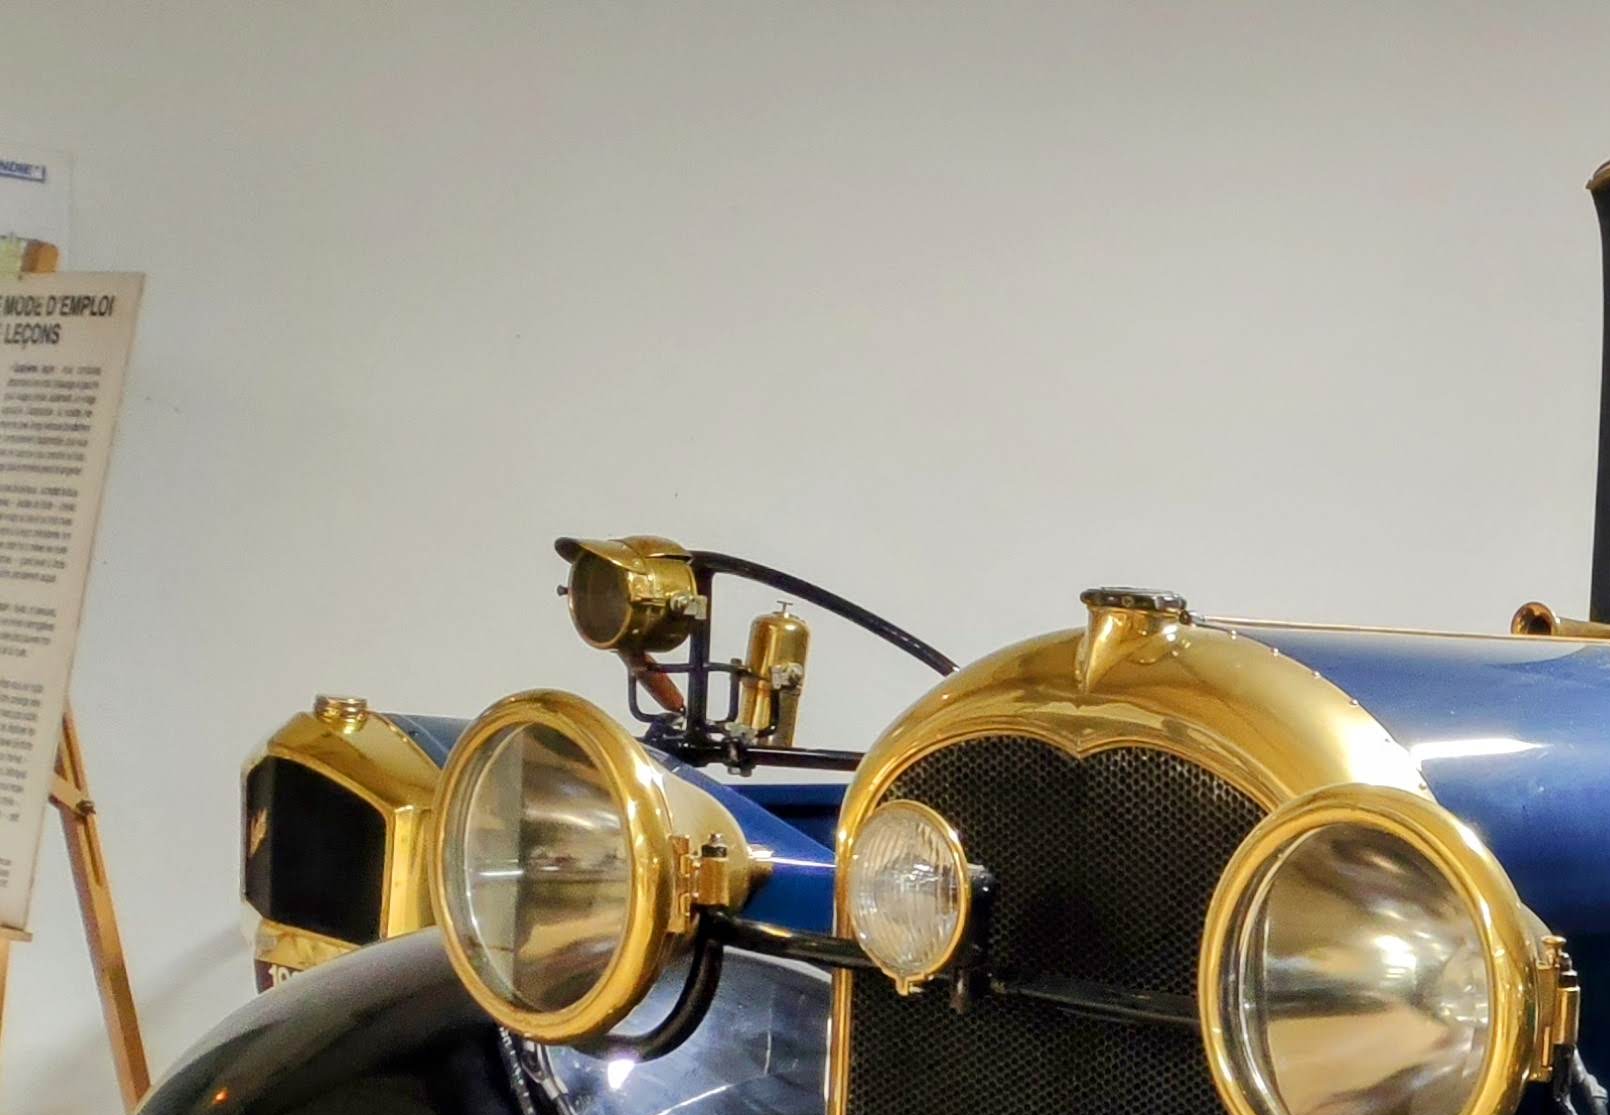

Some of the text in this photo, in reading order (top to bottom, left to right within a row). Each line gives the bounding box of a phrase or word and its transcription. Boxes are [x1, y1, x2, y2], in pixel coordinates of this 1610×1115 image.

[3, 295, 115, 318] MODE D'EMPLOI
[4, 322, 61, 349] LEÇONS
